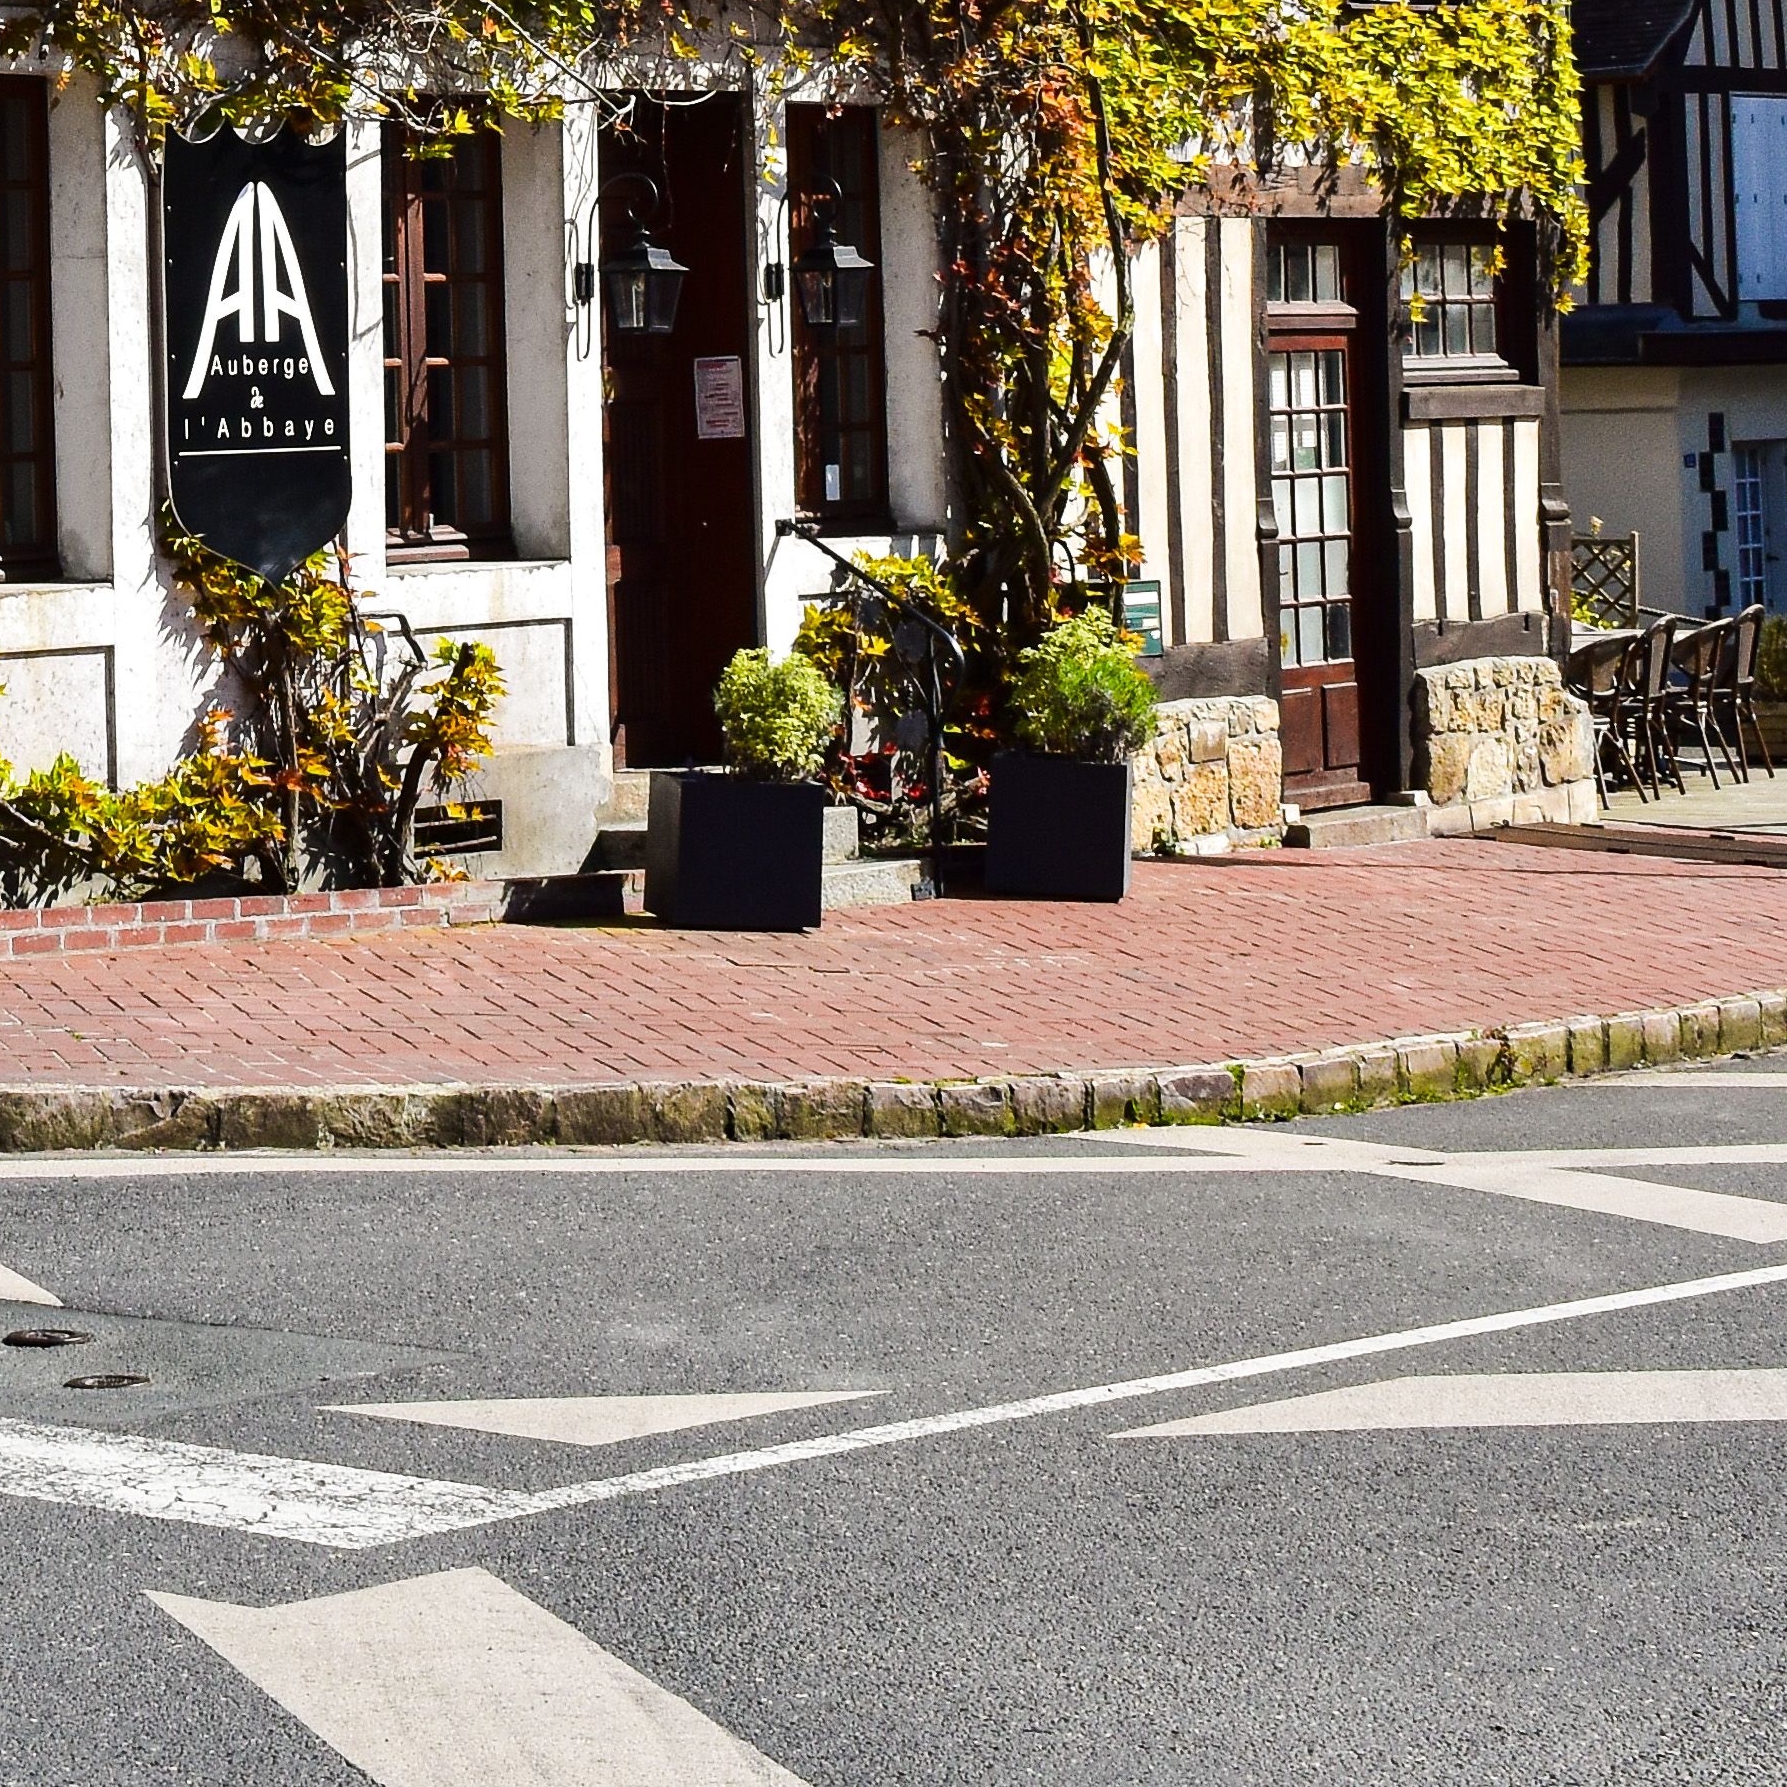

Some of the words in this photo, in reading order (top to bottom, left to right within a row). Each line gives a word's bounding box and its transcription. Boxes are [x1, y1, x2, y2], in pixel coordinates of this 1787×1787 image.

[211, 354, 309, 379] Auberge
[250, 385, 264, 409] de
[184, 416, 334, 441] l'Abbaye
